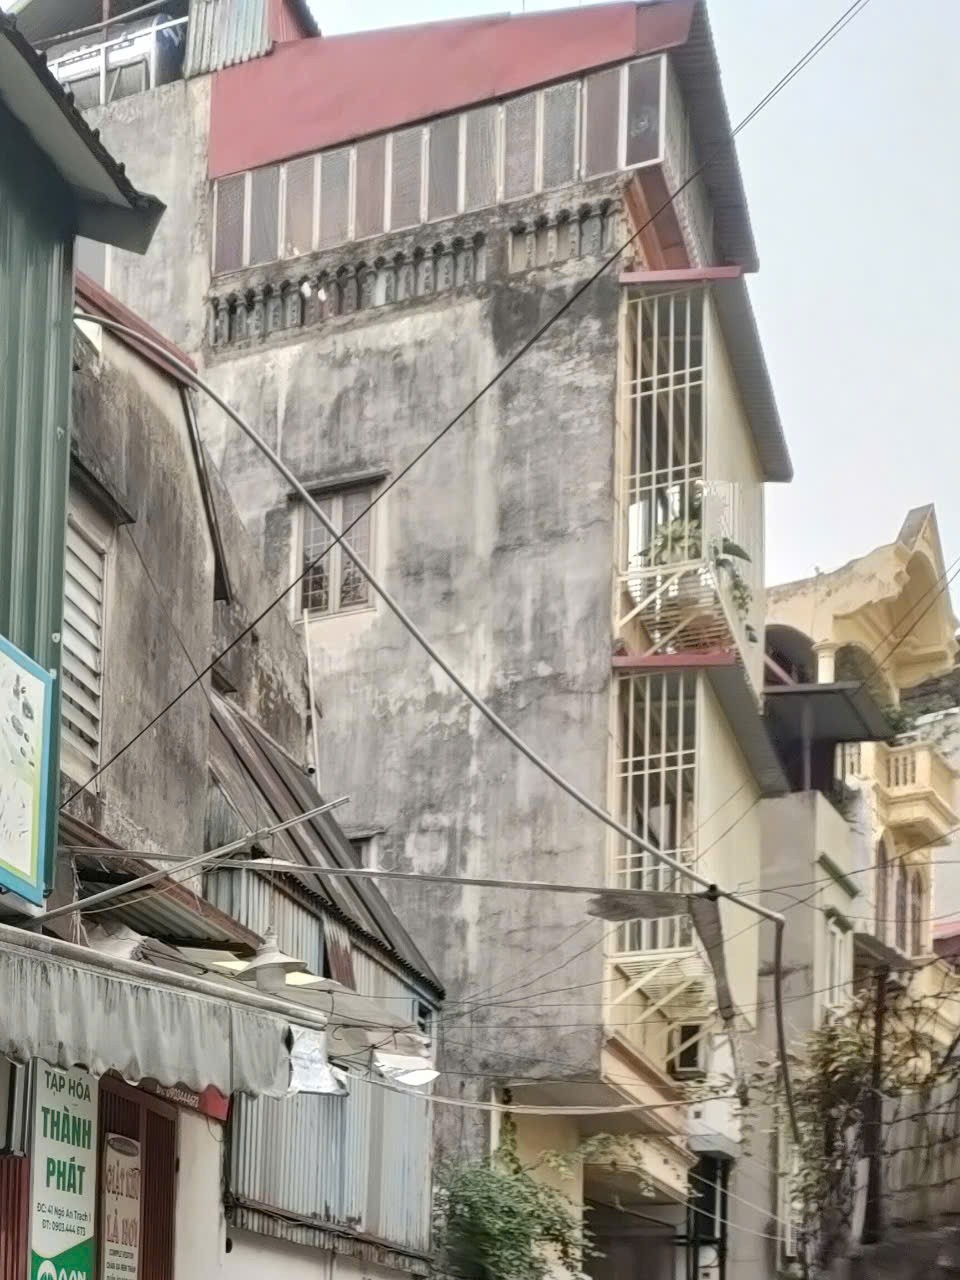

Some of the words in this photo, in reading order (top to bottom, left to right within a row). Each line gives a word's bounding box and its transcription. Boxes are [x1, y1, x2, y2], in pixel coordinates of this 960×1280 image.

[45, 1070, 66, 1096] TẠP
[69, 1077, 91, 1102] HÓA
[41, 1105, 92, 1150] THÀNH
[46, 1155, 86, 1196] PHÁT
